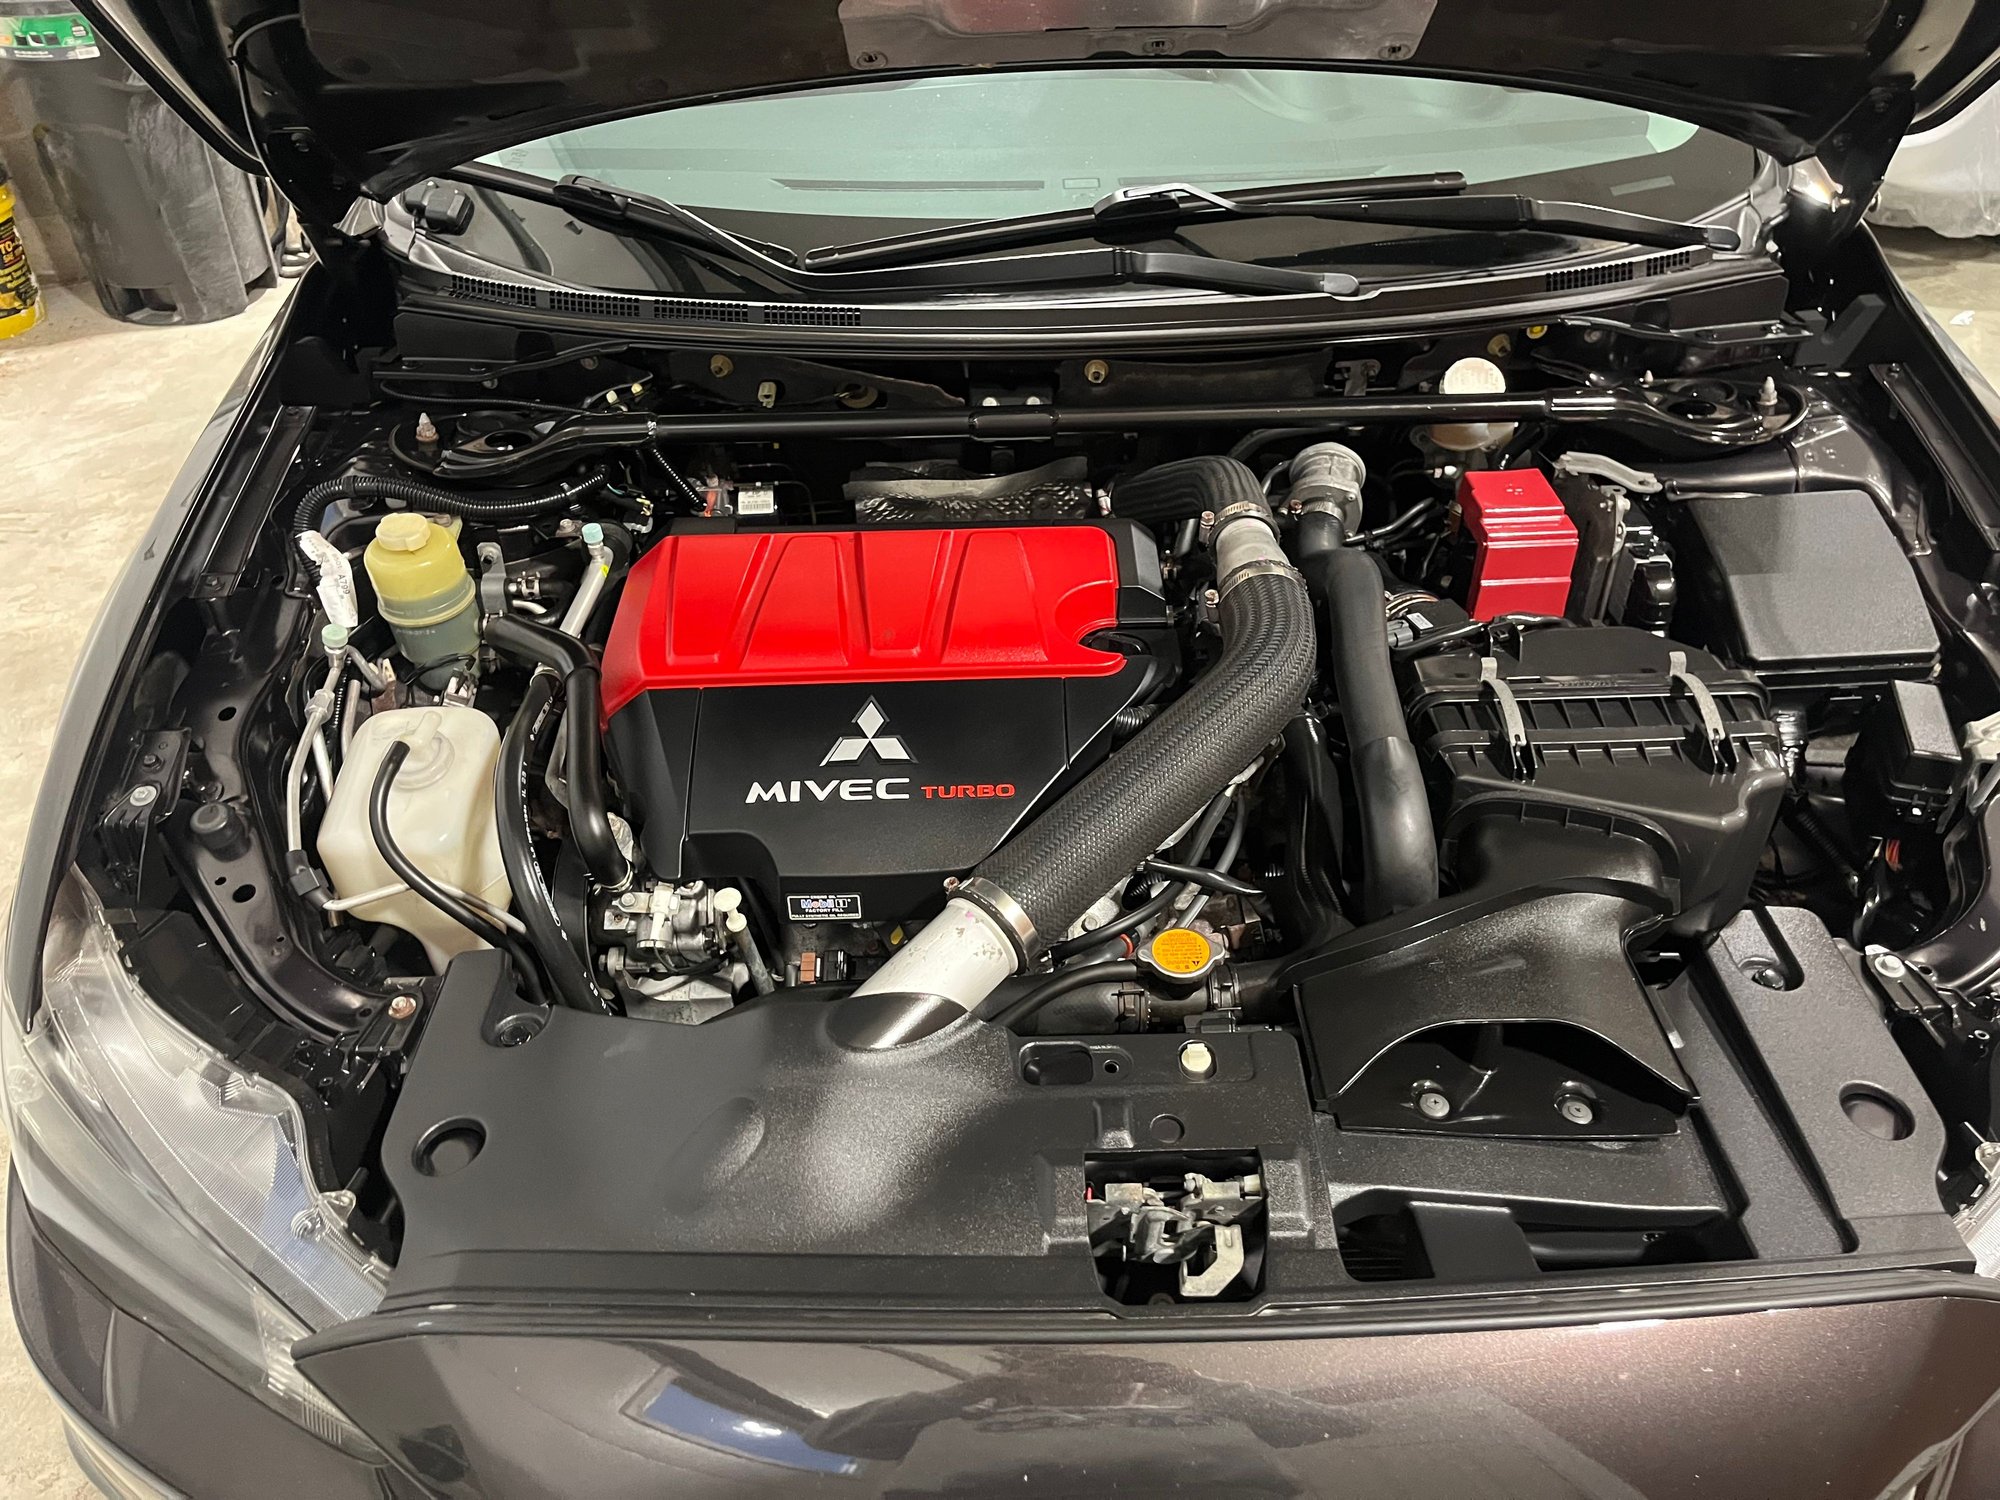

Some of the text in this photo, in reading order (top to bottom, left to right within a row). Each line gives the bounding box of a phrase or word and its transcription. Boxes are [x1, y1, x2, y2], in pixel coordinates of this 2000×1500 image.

[338, 574, 350, 595] A799
[745, 778, 1016, 804] MIVEC TURBO
[801, 899, 834, 908] Mobil
